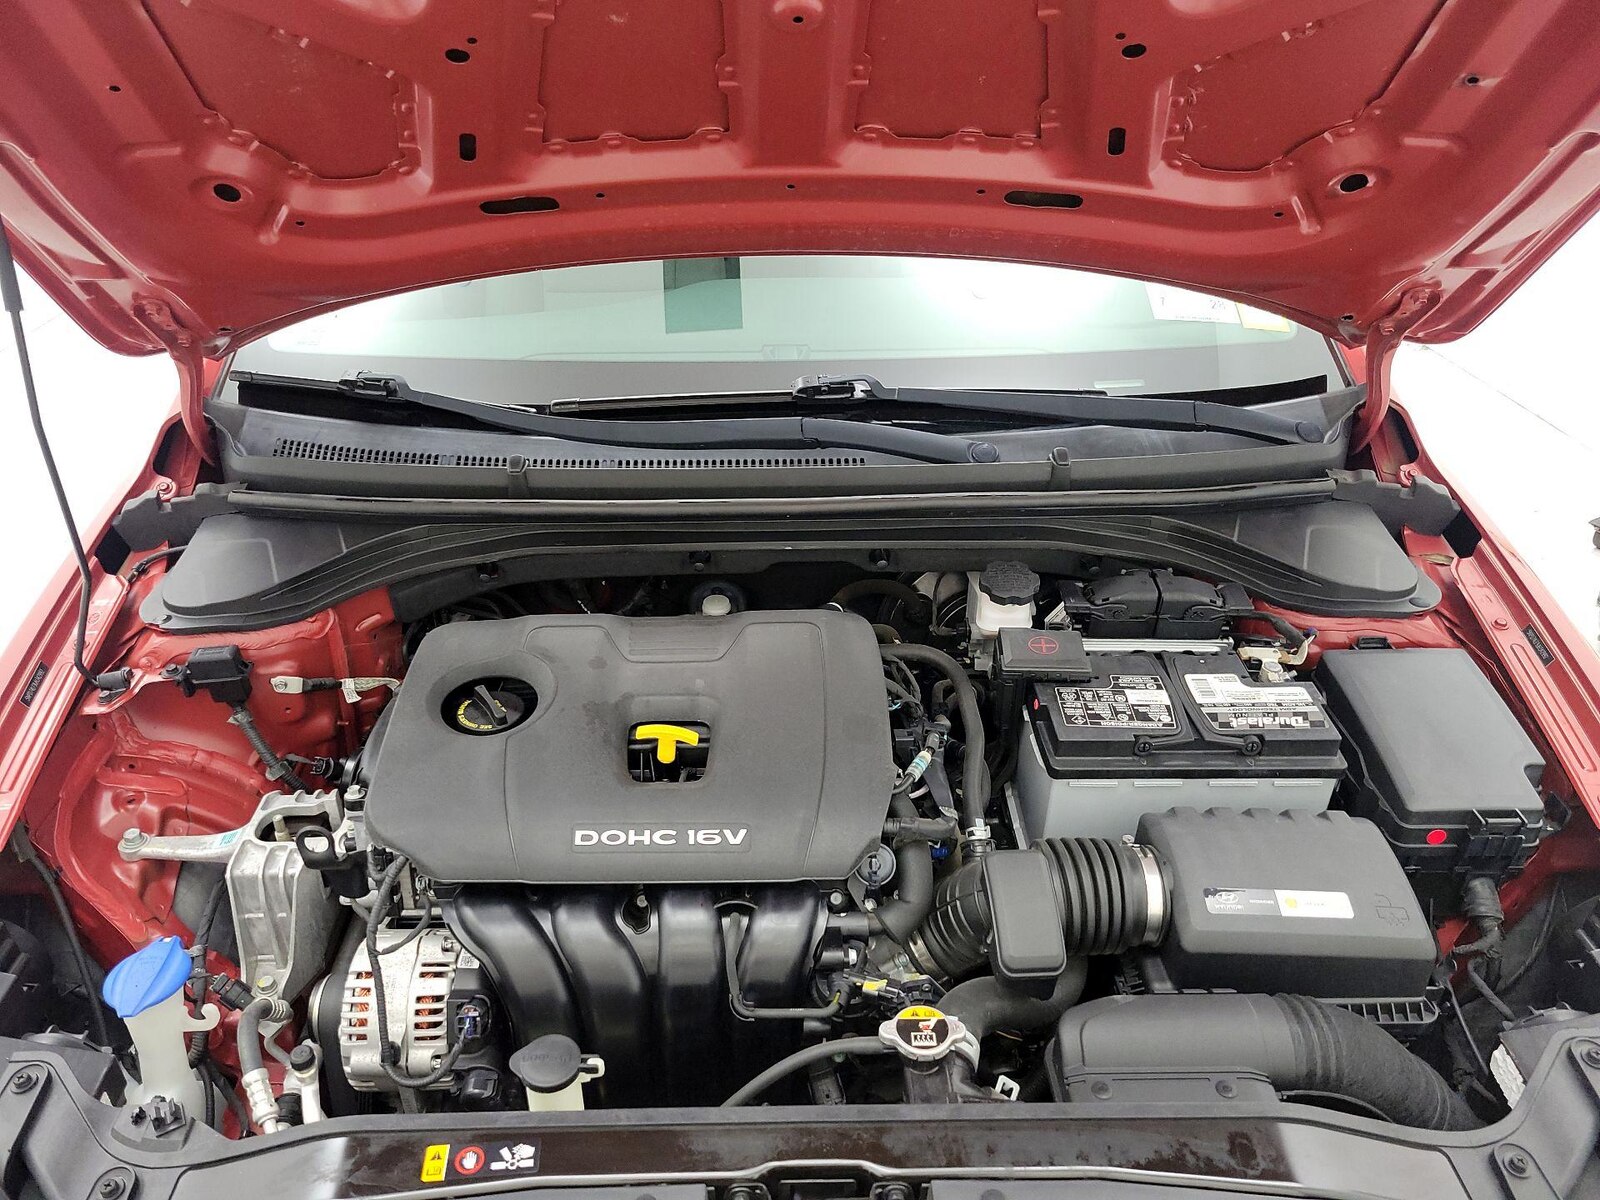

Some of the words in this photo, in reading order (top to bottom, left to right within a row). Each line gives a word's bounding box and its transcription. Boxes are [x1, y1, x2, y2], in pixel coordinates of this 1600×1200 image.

[1229, 716, 1309, 728] Duralast
[574, 829, 677, 846] DOHC
[687, 829, 748, 845] 16V
